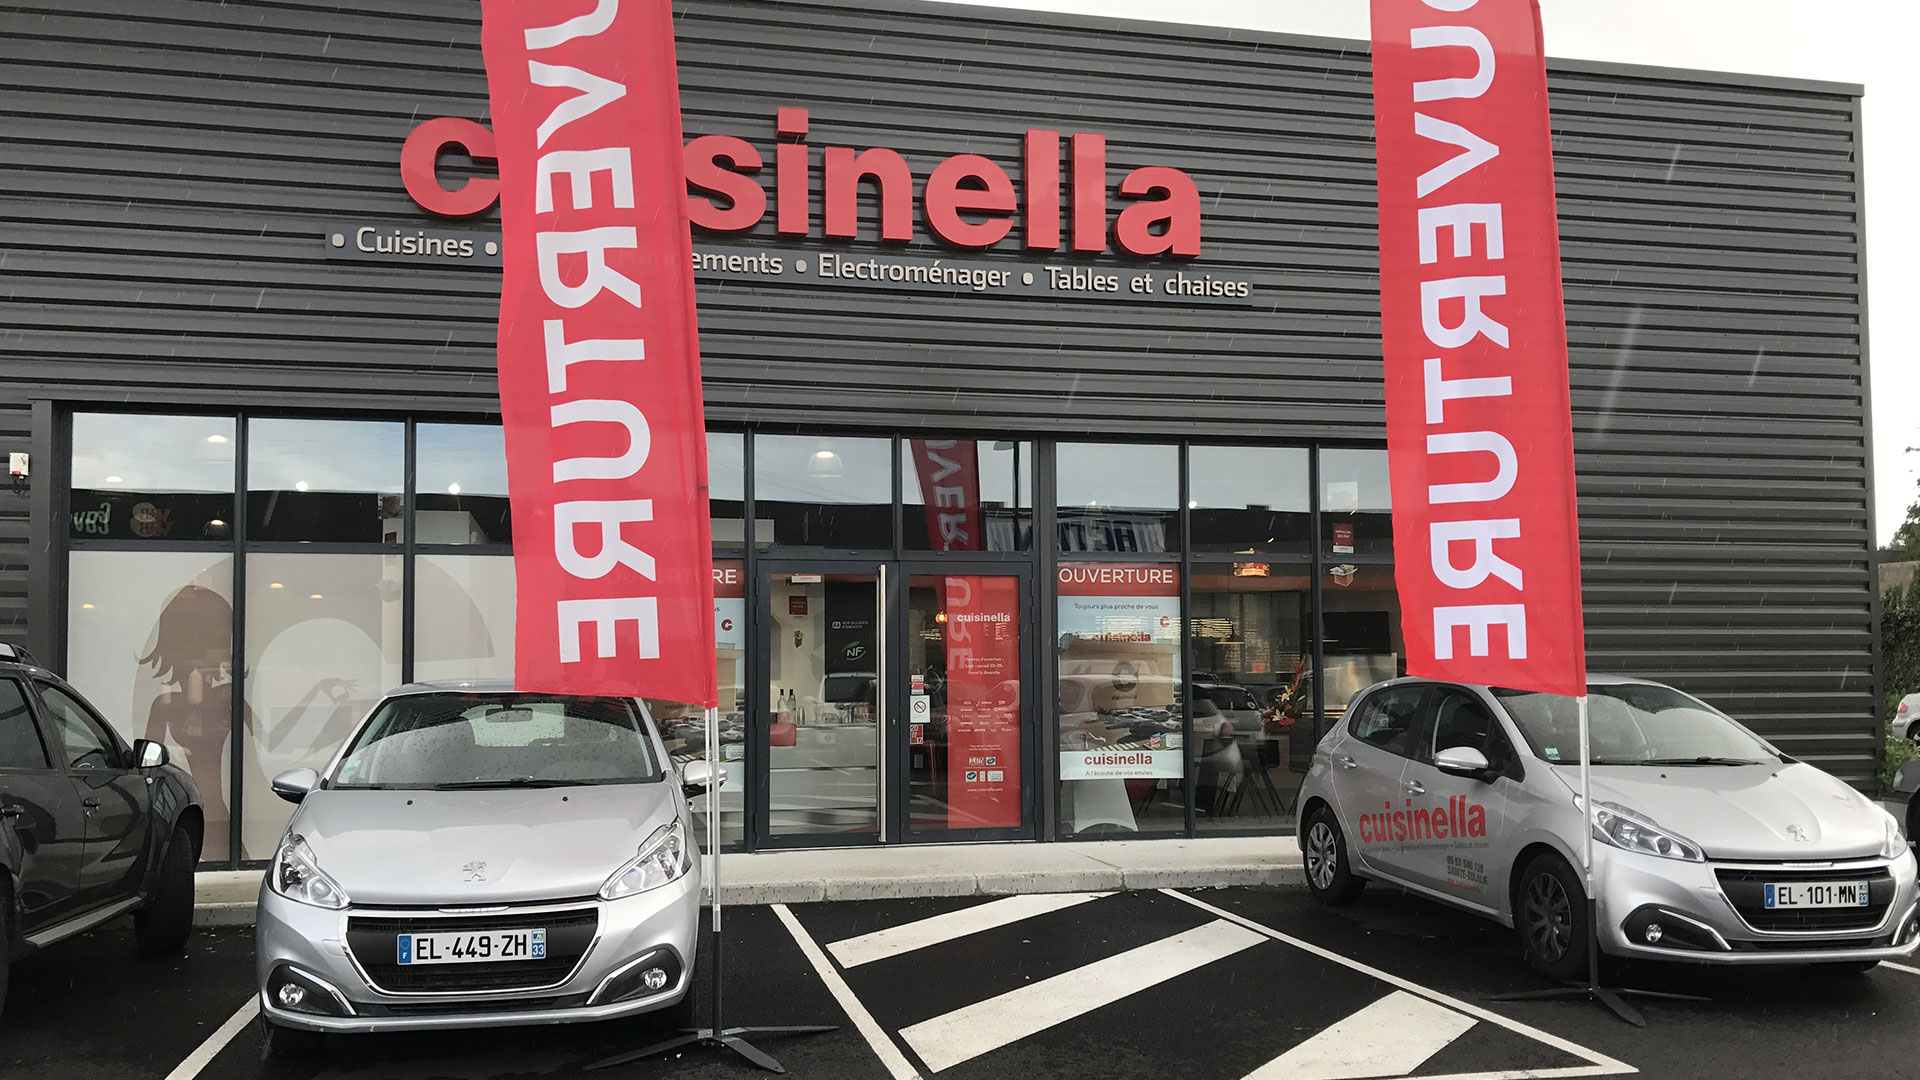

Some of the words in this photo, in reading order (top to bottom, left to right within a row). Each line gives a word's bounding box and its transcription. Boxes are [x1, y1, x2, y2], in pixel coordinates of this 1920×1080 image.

[401, 107, 1201, 257] csinella
[356, 226, 474, 257] Cuisines
[692, 250, 784, 275] ements
[819, 252, 1011, 292] Electroménager
[1044, 265, 1119, 293] Tables
[1130, 274, 1154, 295] et
[1164, 271, 1249, 298] chaises
[1058, 568, 1174, 584] OUVERTURE
[1074, 603, 1100, 611] Toujours
[1100, 603, 1113, 611] plus
[1113, 603, 1136, 611] proche
[957, 612, 1011, 622] cuisinella
[846, 646, 864, 657] NF
[1084, 752, 1153, 766] cuisinella
[1359, 794, 1487, 844] cuisinella
[1778, 885, 1857, 905] EL-101-MN
[416, 934, 528, 960] EL-449-ZH
[532, 944, 545, 956] 33
